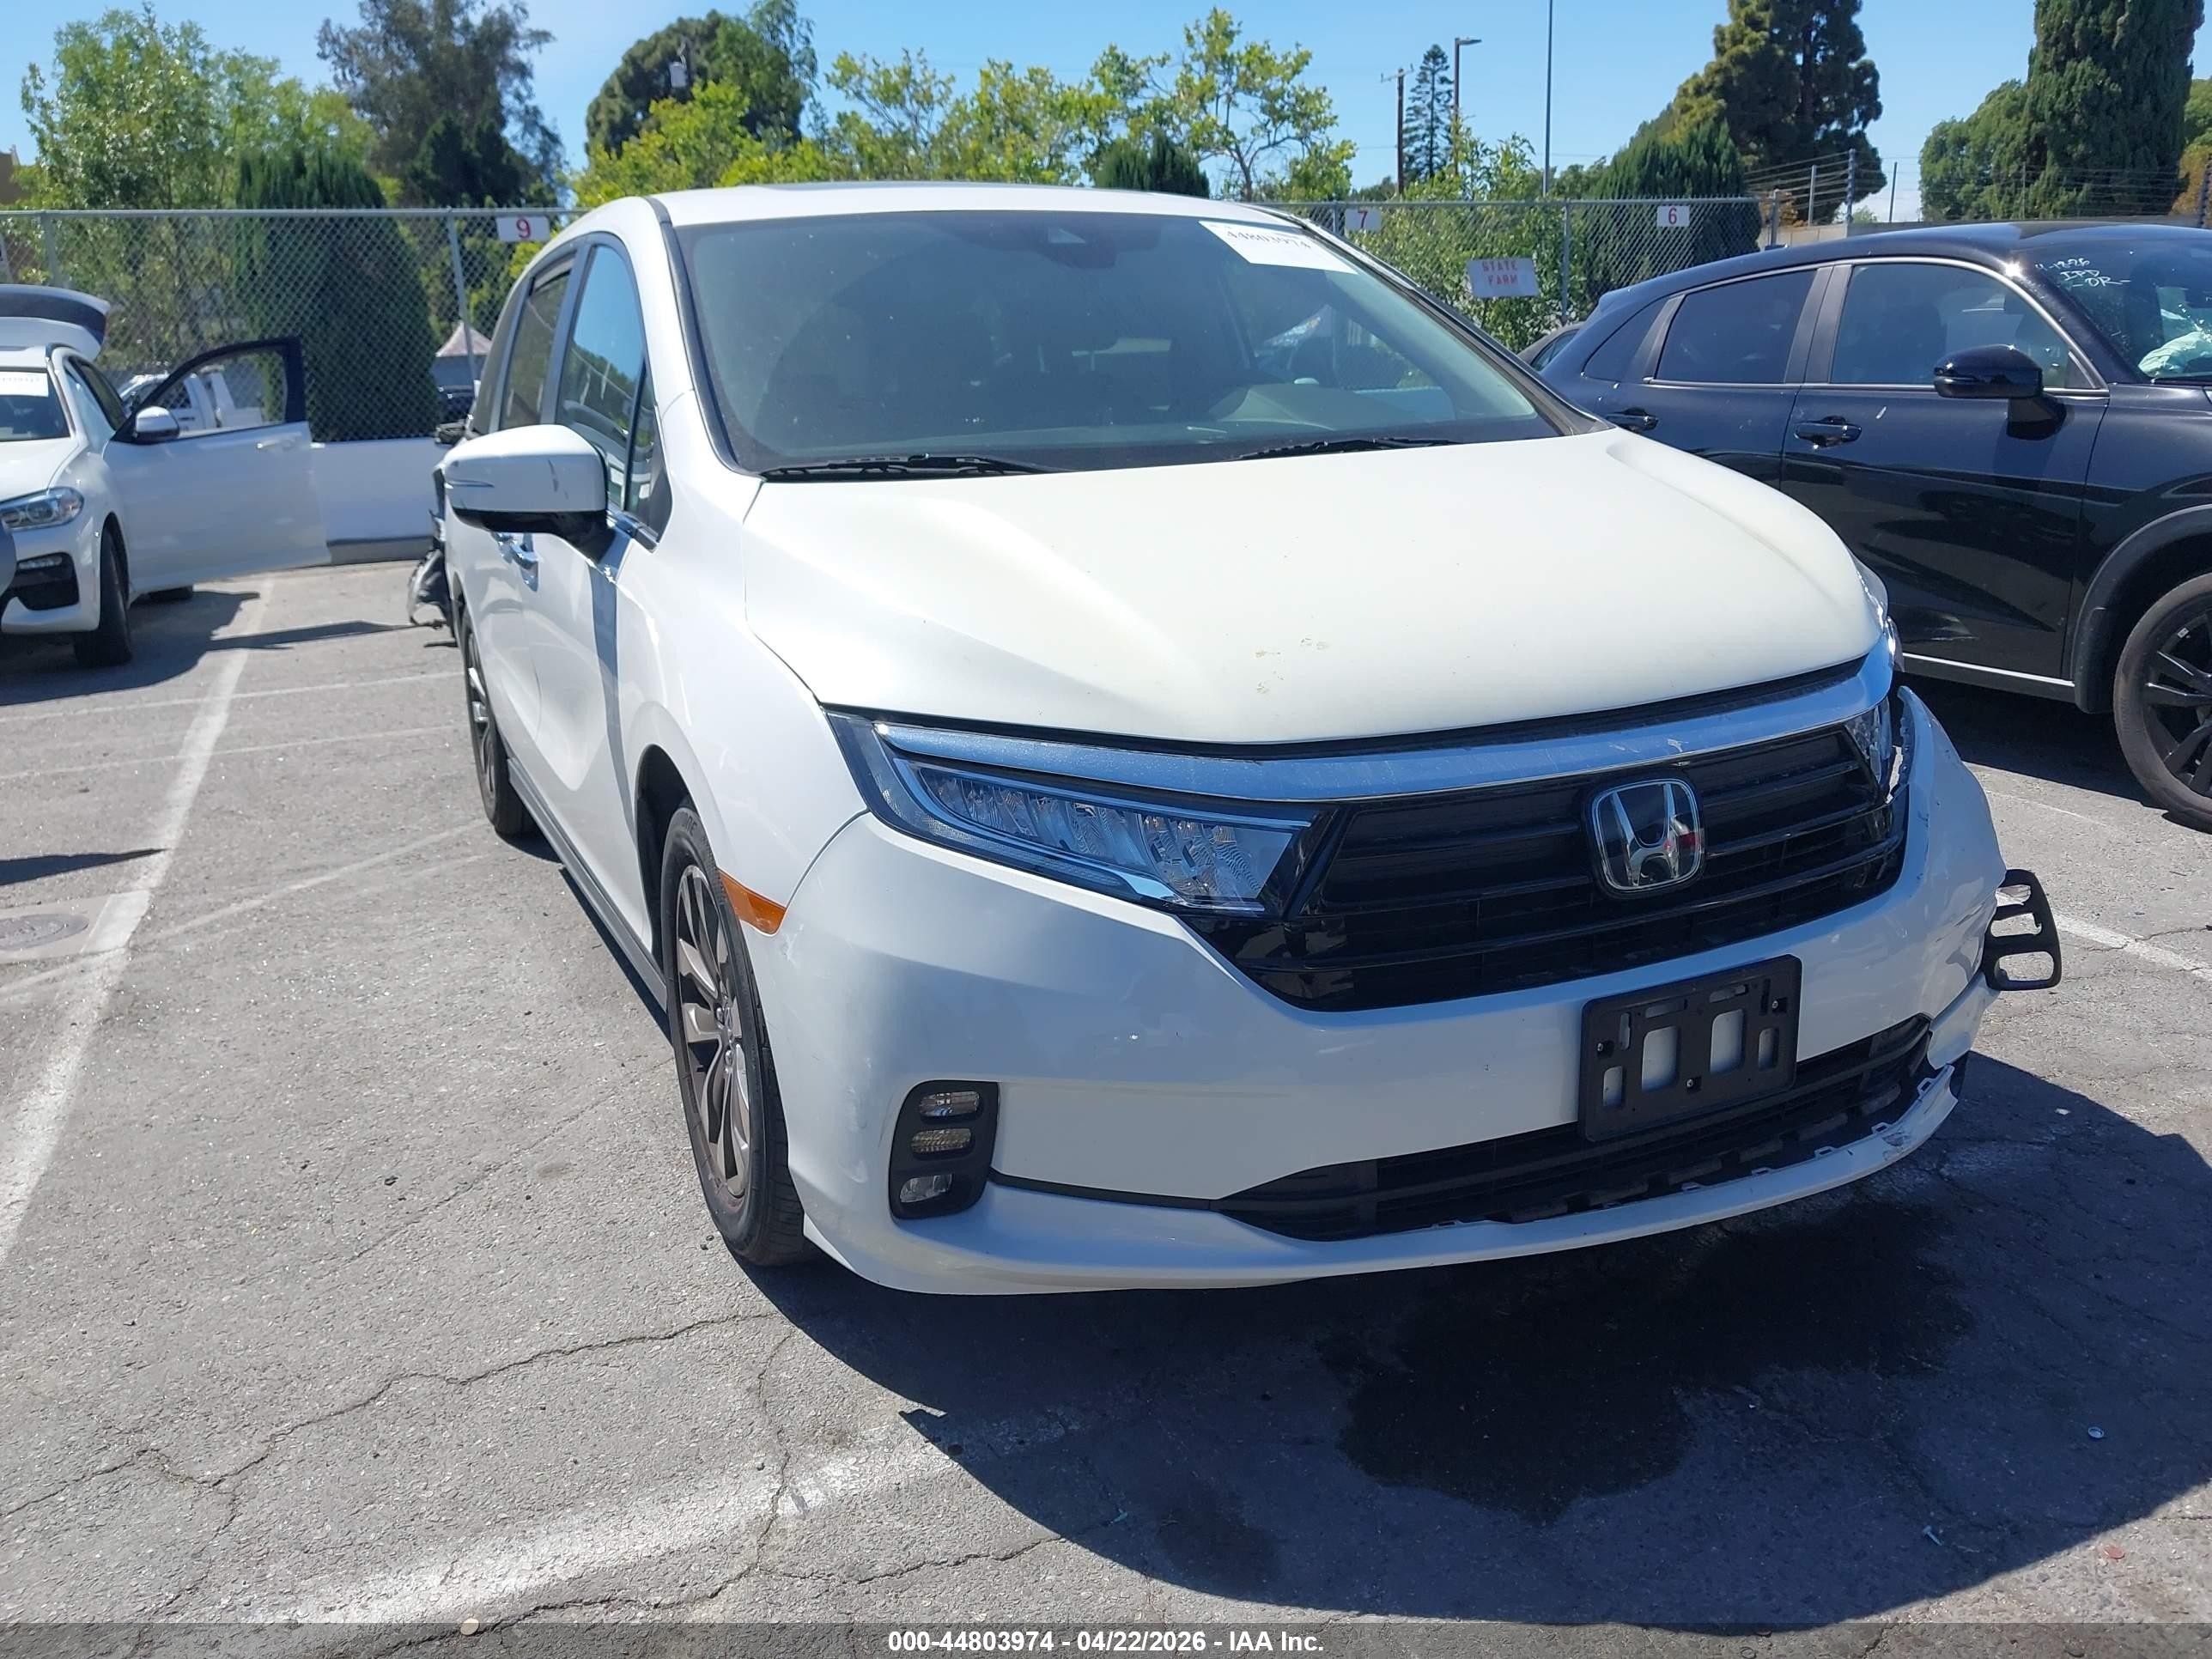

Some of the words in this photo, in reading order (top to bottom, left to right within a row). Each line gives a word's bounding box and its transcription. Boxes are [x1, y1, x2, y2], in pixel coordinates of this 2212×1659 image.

[1357, 210, 1369, 229] 7
[1668, 206, 1678, 225] 6
[515, 218, 531, 239] 9
[1481, 259, 1518, 271] STATE
[1487, 274, 1518, 285] FARM
